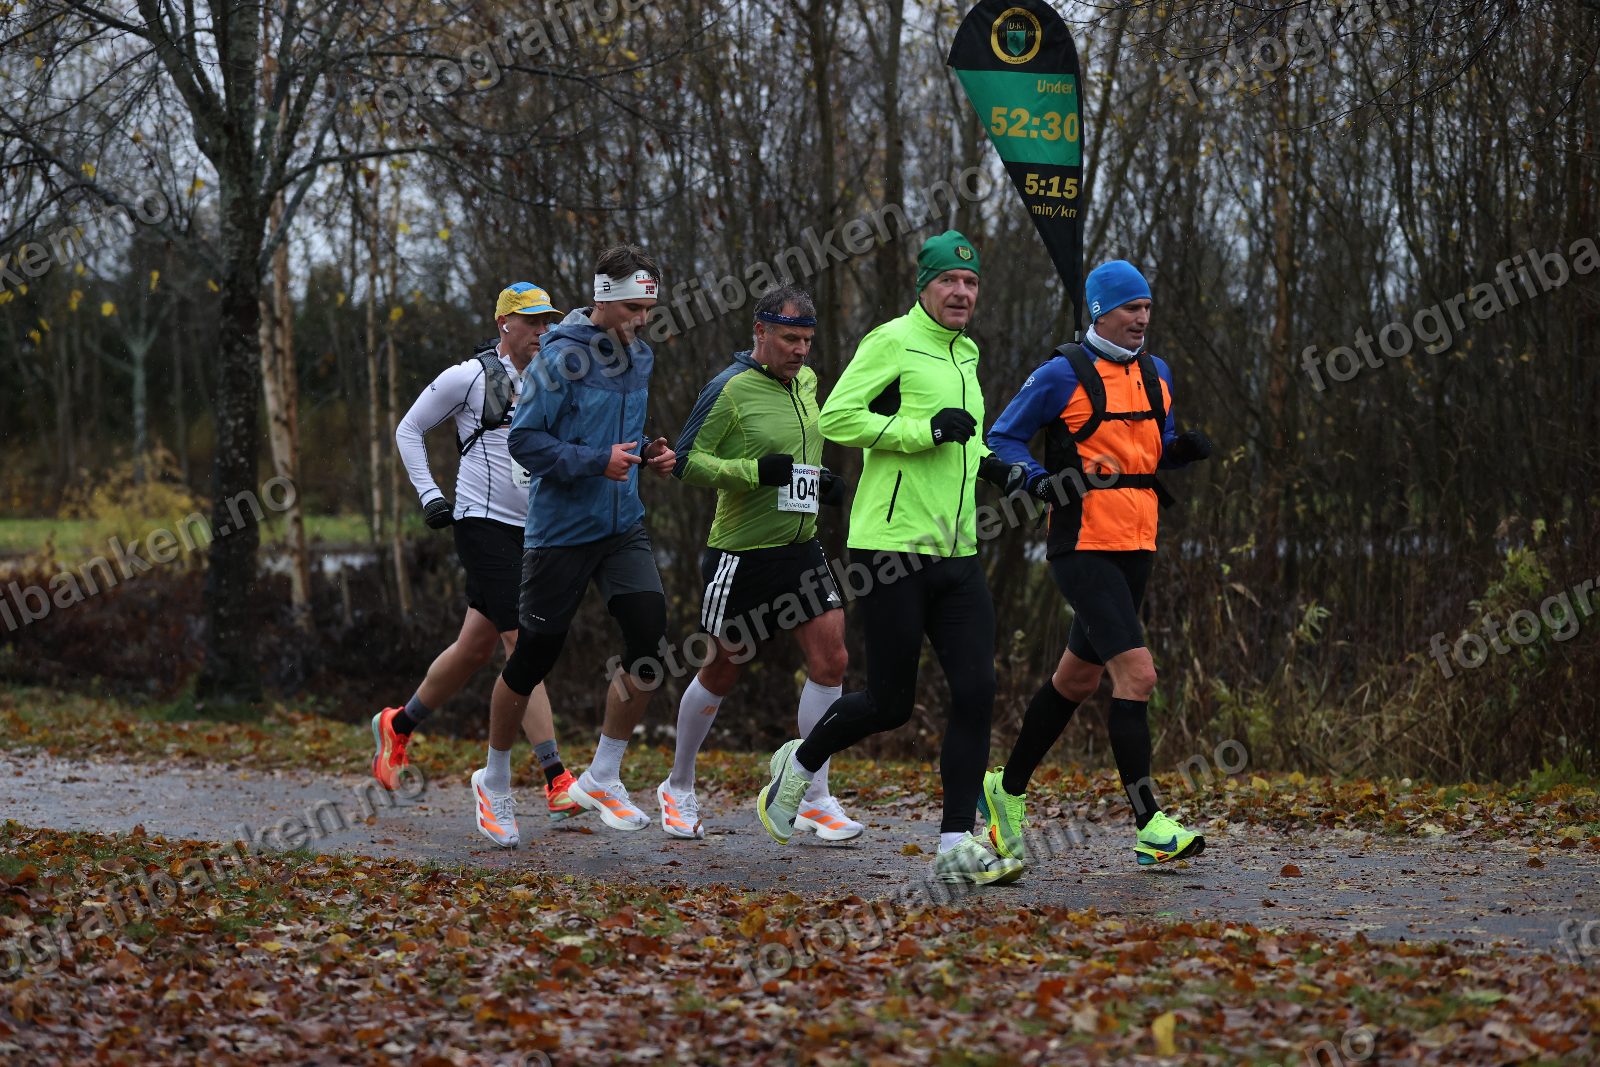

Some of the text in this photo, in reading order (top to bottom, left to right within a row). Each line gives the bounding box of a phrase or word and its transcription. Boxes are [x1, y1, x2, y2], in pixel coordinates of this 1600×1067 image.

[1037, 79, 1073, 94] Under
[991, 106, 1079, 142] 52:30
[1025, 173, 1078, 199] 5:15
